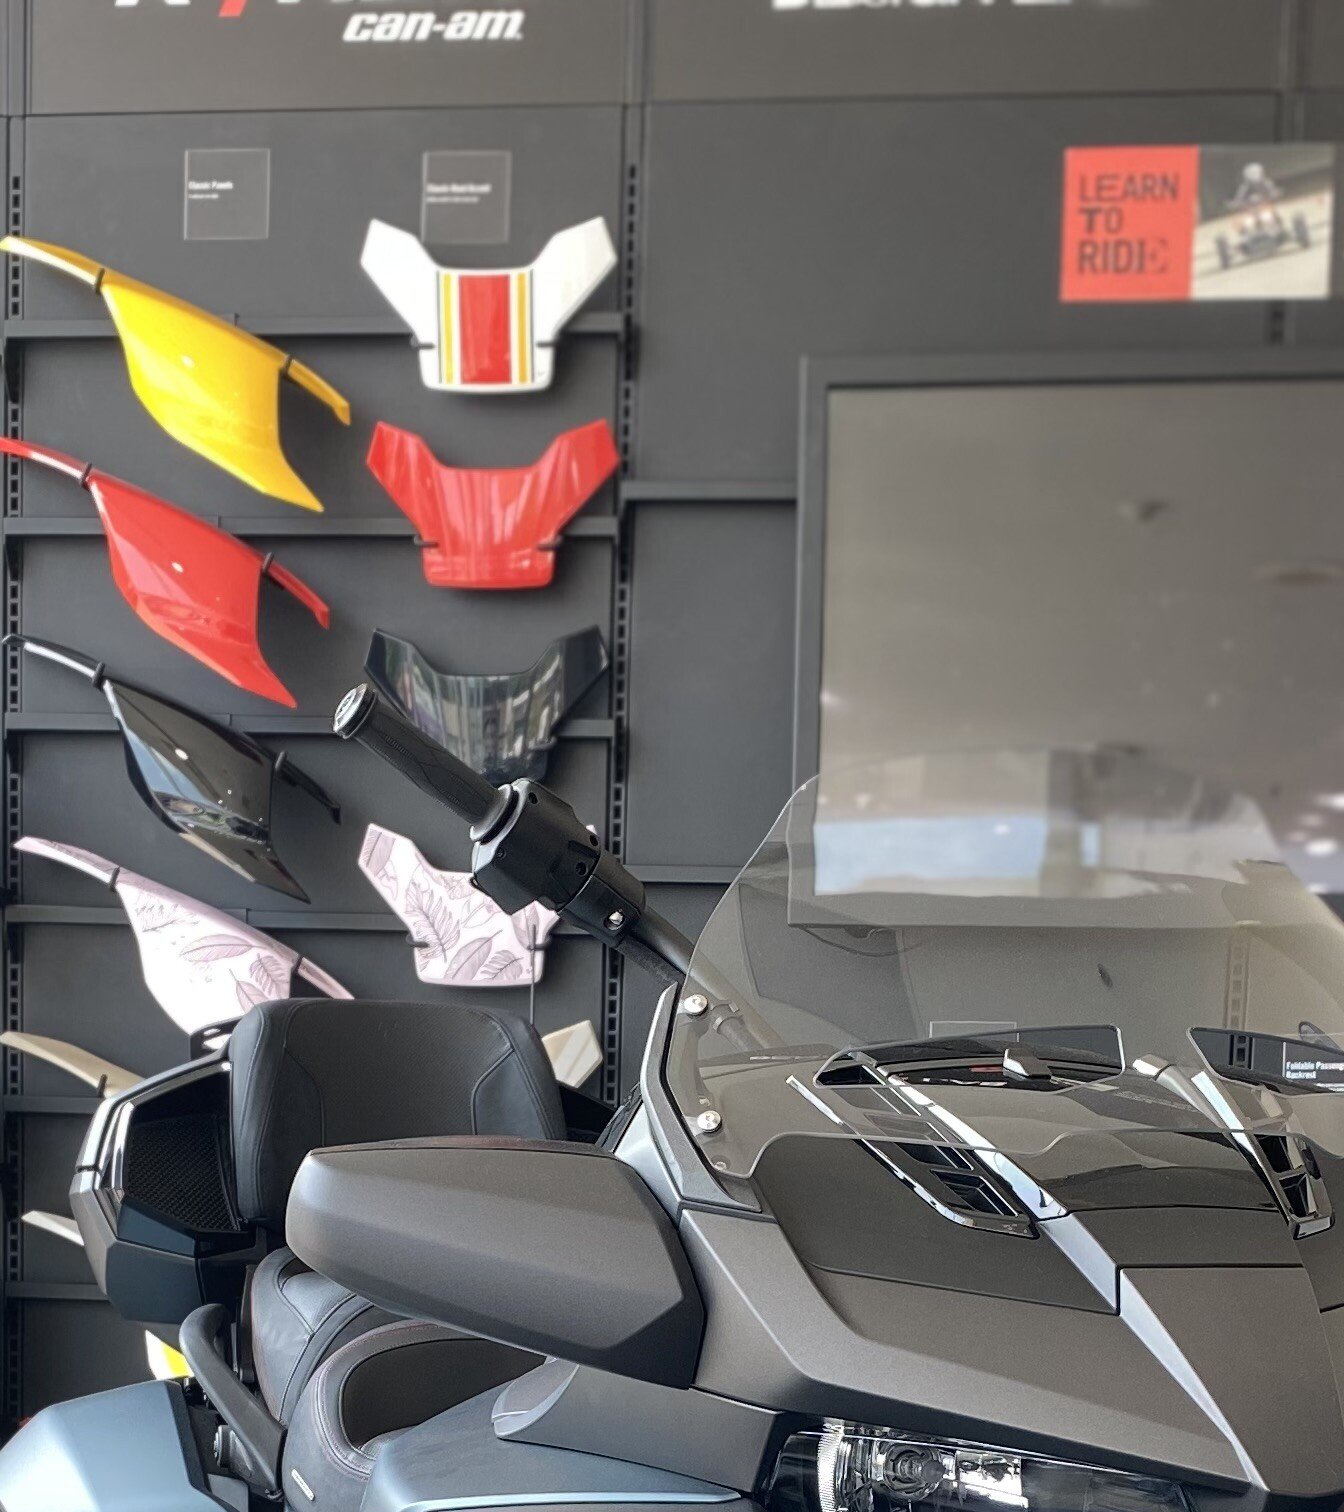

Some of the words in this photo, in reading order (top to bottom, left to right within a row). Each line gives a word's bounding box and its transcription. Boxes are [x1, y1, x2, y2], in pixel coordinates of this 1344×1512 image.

[342, 10, 525, 42] can-am
[1079, 173, 1180, 201] LEARN
[1079, 206, 1125, 234] TO
[1286, 1061, 1315, 1071] Foldable
[1286, 1070, 1317, 1079] Backrest
